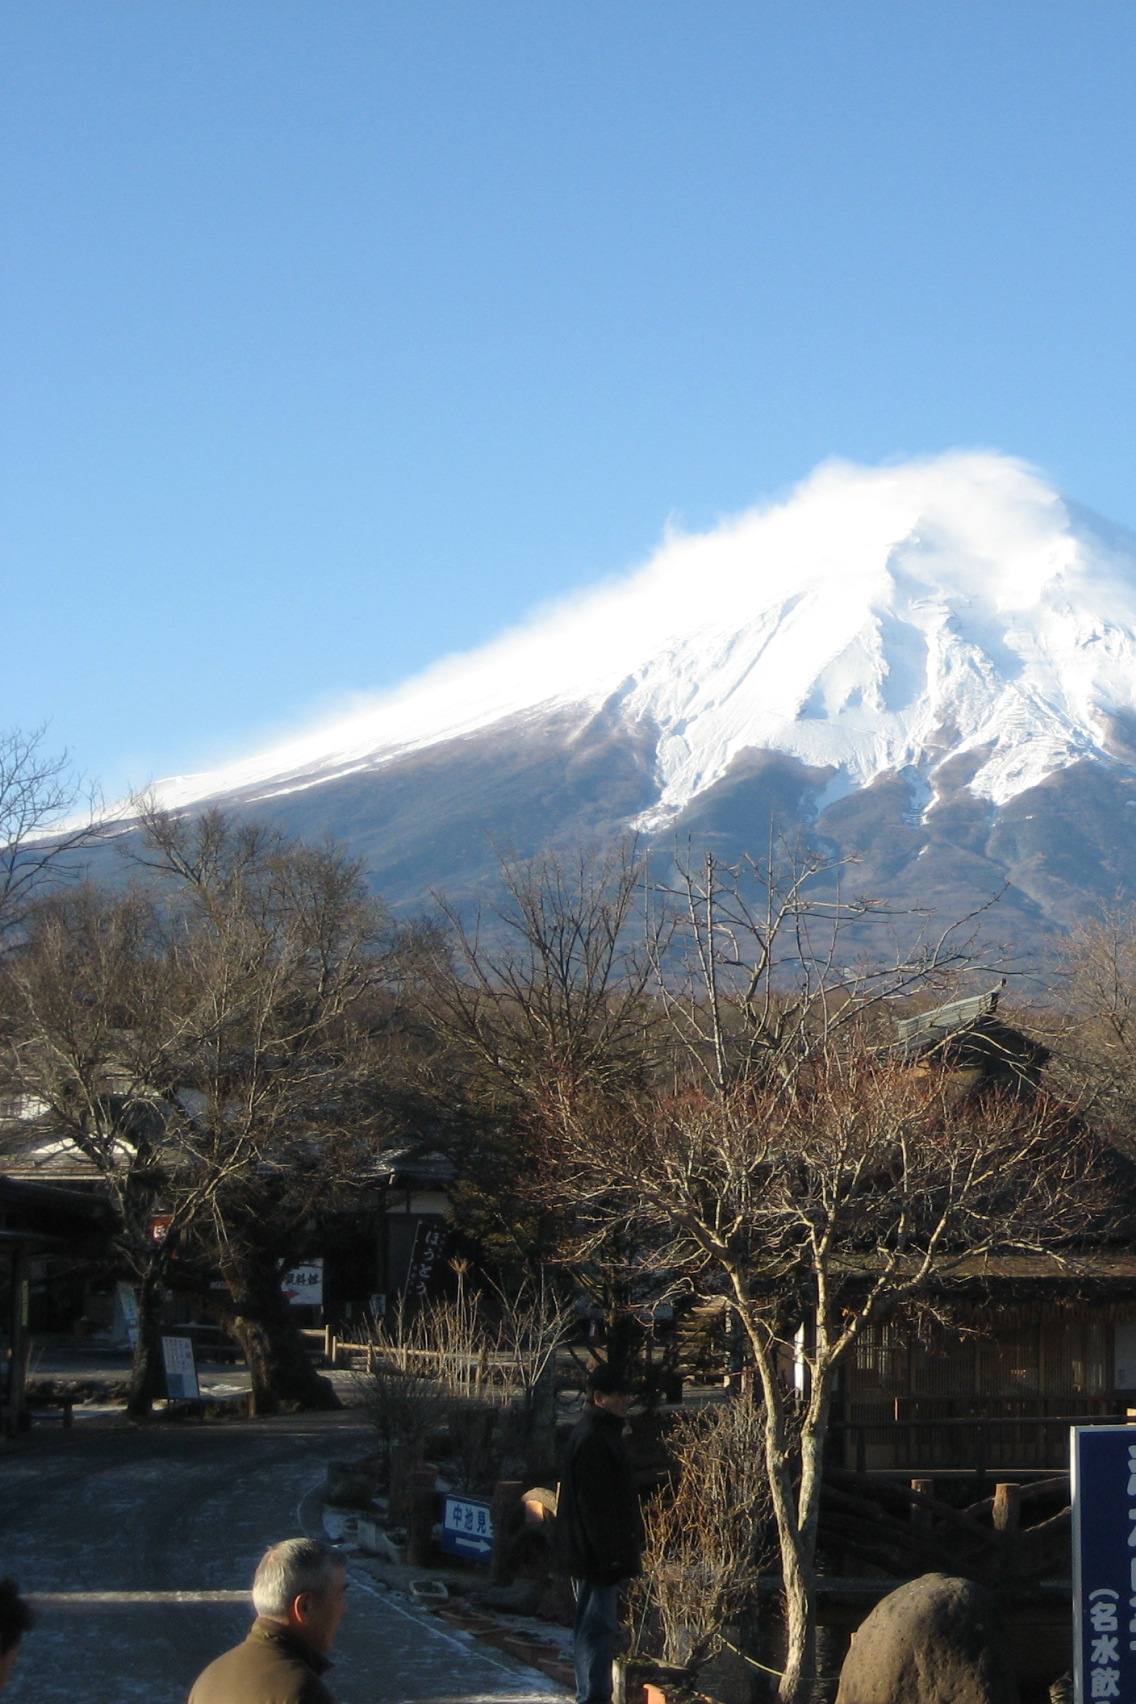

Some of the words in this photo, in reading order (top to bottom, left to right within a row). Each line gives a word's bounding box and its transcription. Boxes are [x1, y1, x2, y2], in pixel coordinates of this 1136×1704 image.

[415, 1230, 440, 1295] ほうとう
[452, 1503, 494, 1535] 中池見
